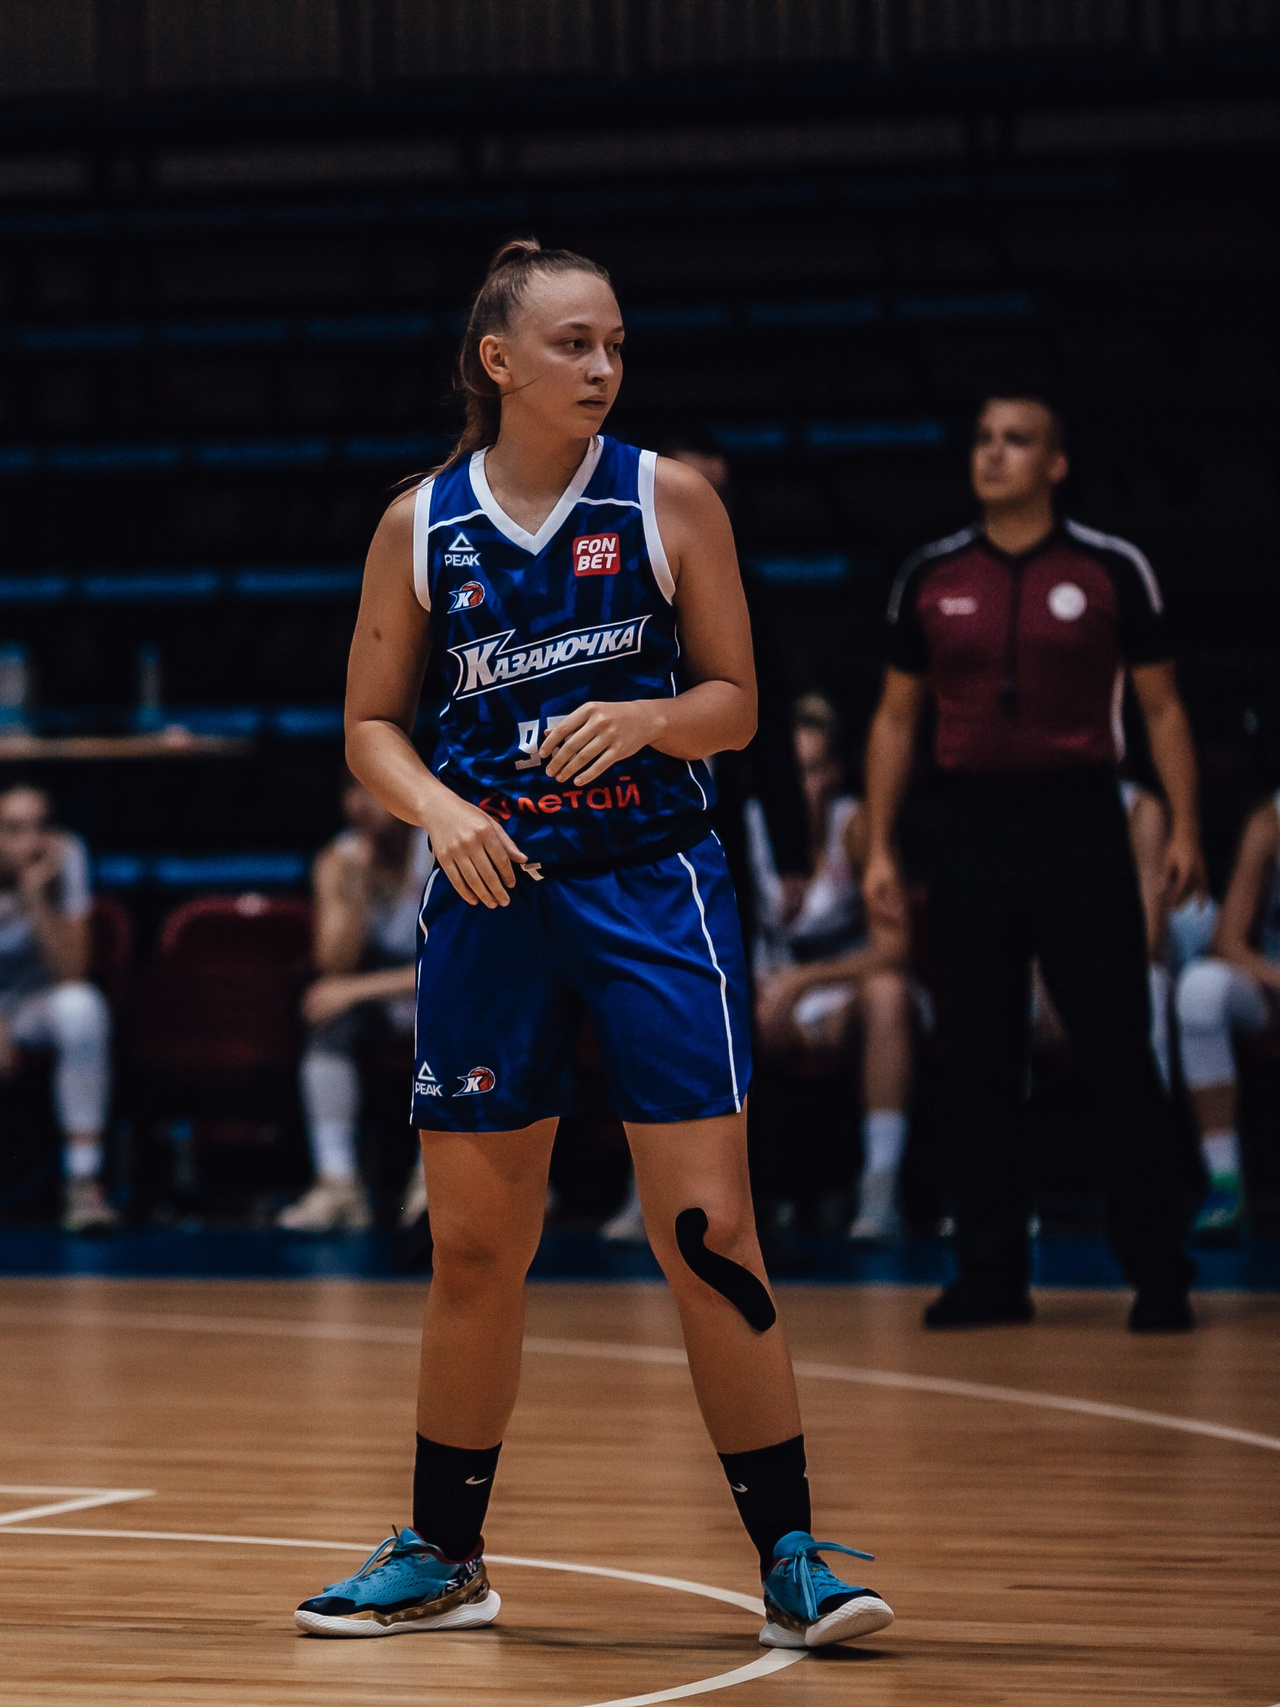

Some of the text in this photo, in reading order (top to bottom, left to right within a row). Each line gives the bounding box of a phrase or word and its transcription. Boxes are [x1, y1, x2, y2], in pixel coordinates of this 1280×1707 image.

[576, 537, 616, 555] FON
[444, 552, 481, 567] PEAK
[577, 553, 617, 571] BET
[415, 1081, 443, 1097] PEAK
